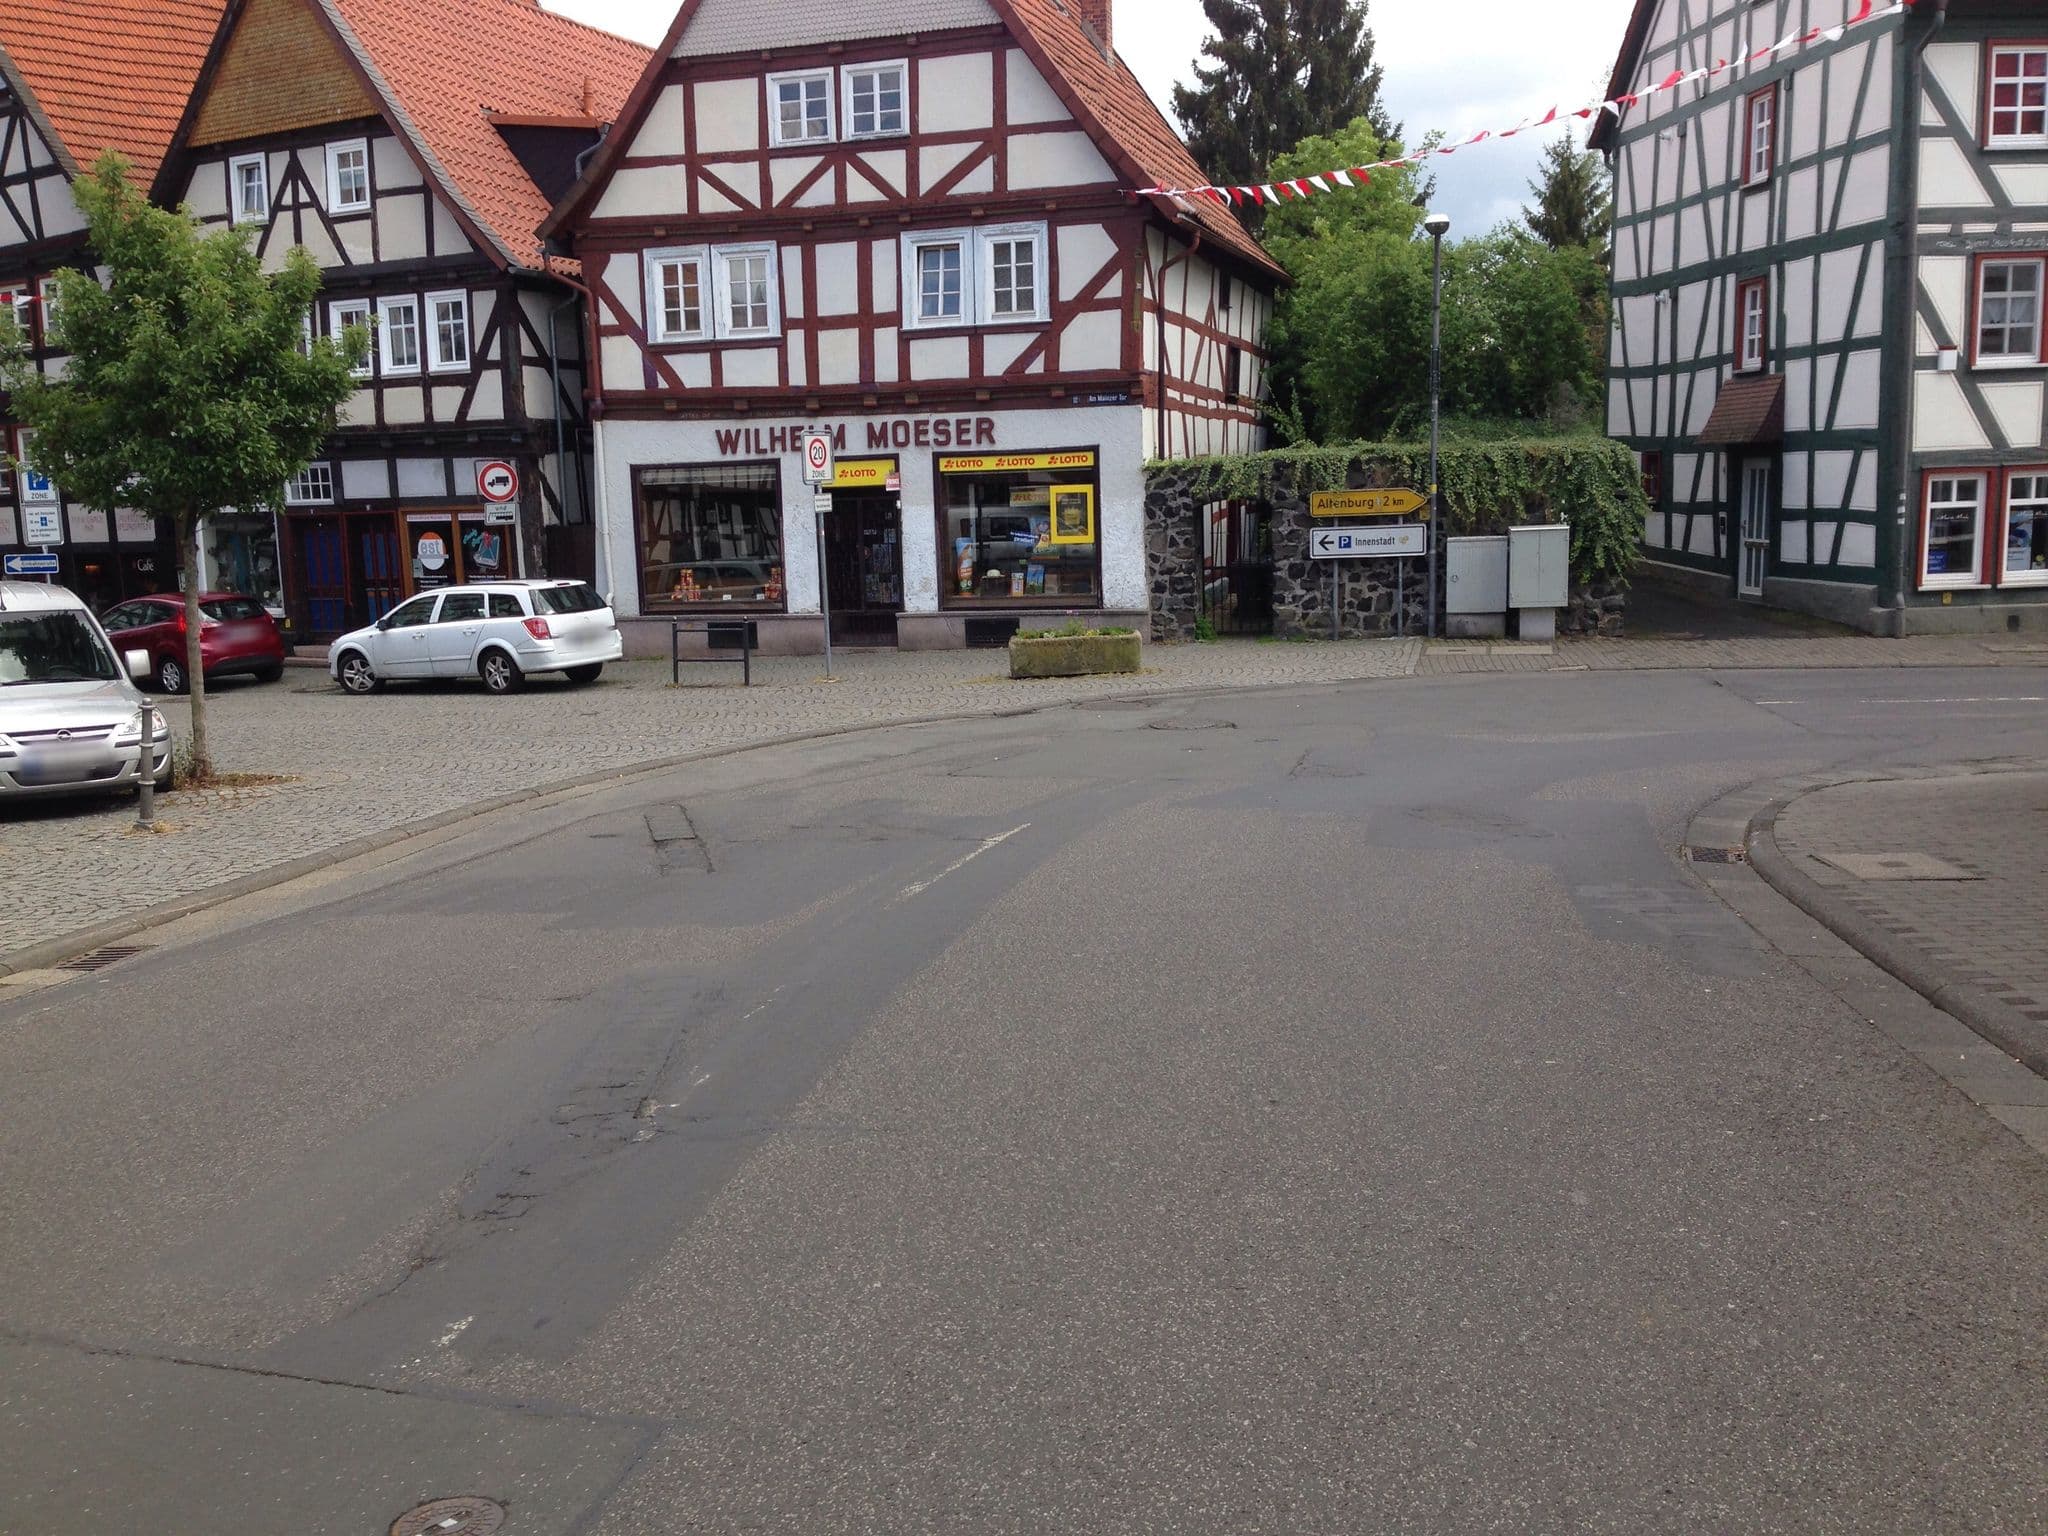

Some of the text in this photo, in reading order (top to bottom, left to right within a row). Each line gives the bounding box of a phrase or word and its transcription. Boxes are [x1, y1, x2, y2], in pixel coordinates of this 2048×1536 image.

[715, 418, 996, 455] WILHEM MOESER
[813, 446, 823, 460] 20
[956, 455, 1088, 468] LOTTO LOTTO LOTTO
[811, 470, 826, 478] ZONE
[850, 469, 877, 478] LOTTO
[31, 492, 49, 500] ZONE
[1317, 495, 1404, 510] Altenburg 2 km
[1341, 536, 1395, 547] P Innenstadt
